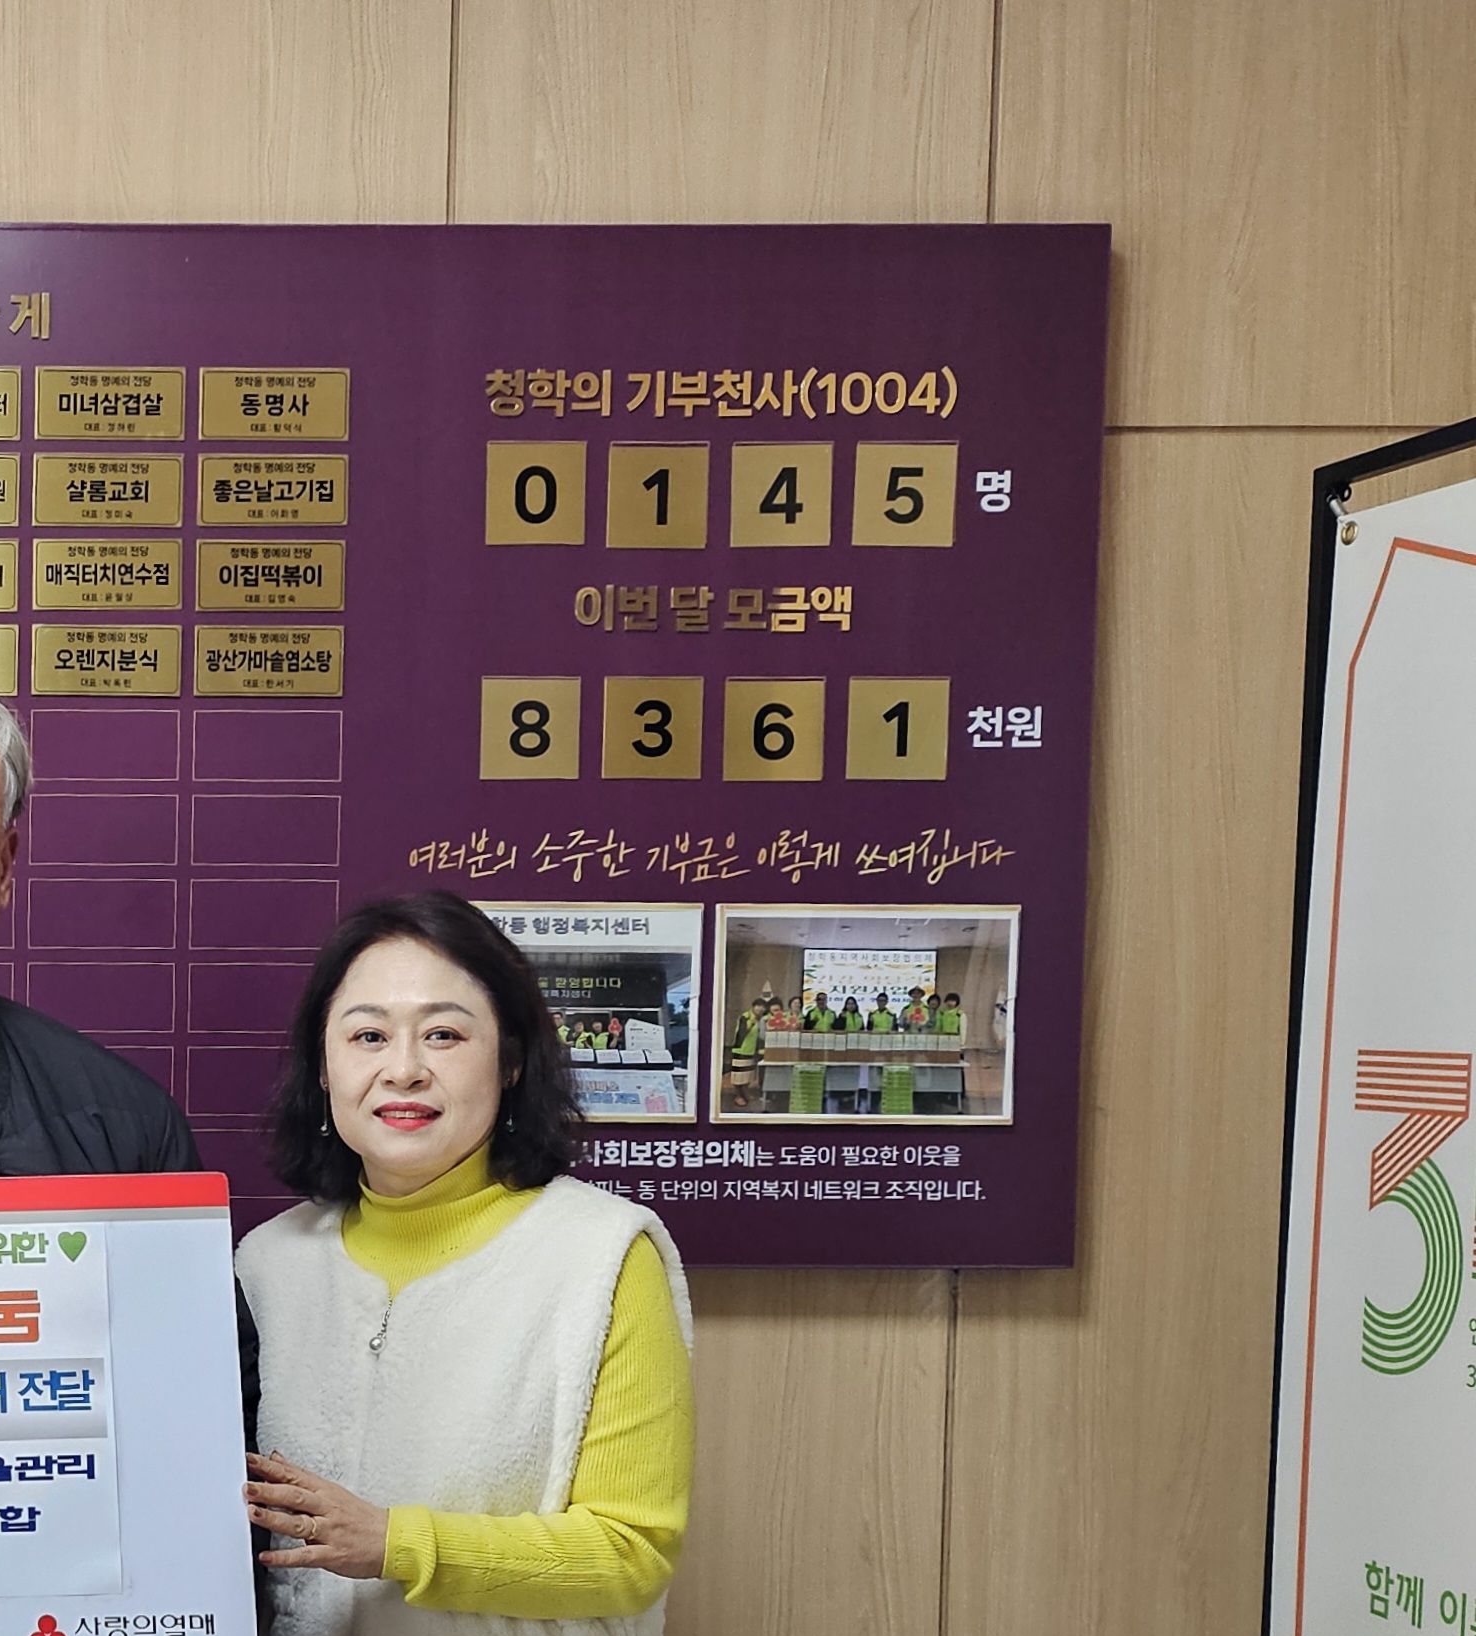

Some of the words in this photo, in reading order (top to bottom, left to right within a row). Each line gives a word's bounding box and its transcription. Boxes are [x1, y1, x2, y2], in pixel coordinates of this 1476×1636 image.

[235, 376, 262, 387] 청학동
[266, 377, 294, 388] 명예의
[295, 377, 316, 388] 전당
[485, 368, 612, 418] 청학의
[627, 366, 958, 419] 기부천사(1004)
[59, 393, 163, 416] 미녀삼겹살
[241, 394, 309, 416] 동명사
[68, 463, 96, 473] 청학동
[99, 463, 127, 474] 명예의
[131, 463, 149, 474] 전당
[67, 480, 149, 503] 샬롬교회
[213, 480, 333, 502] 좋은날고기집
[976, 470, 1011, 512] 명
[231, 548, 259, 559] 청학동
[262, 548, 290, 559] 명예의
[294, 548, 312, 559] 전당
[45, 563, 169, 586] 매직터치연수점
[219, 565, 322, 587] 이집떡볶이
[574, 585, 657, 632] 이번
[670, 586, 714, 633] 달
[724, 586, 852, 633] 모금액
[229, 633, 257, 644] 청학동
[260, 633, 288, 644] 명예의
[292, 633, 310, 644] 전당
[55, 649, 157, 672] 오렌지분식
[206, 649, 332, 672] 광산가마솥염소탕
[967, 706, 1042, 747] 천원
[409, 830, 516, 873] 여러분의
[531, 830, 636, 882] 소중한
[647, 839, 748, 884] 기부금은
[757, 831, 840, 880] 이렇게
[855, 828, 1015, 885] 쓰여집니다
[532, 917, 649, 935] 행정복지센터
[779, 1146, 835, 1167] 도움이
[841, 1145, 899, 1167] 필요한
[904, 1145, 961, 1167] 이웃을
[639, 1180, 656, 1201] 동
[661, 1180, 718, 1200] 단위의
[723, 1180, 799, 1201] 지역복지
[804, 1180, 880, 1201] 네트워크
[885, 1180, 986, 1202] 조직입니다.
[19, 1370, 95, 1411] 전달
[1365, 1561, 1423, 1629] 함께
